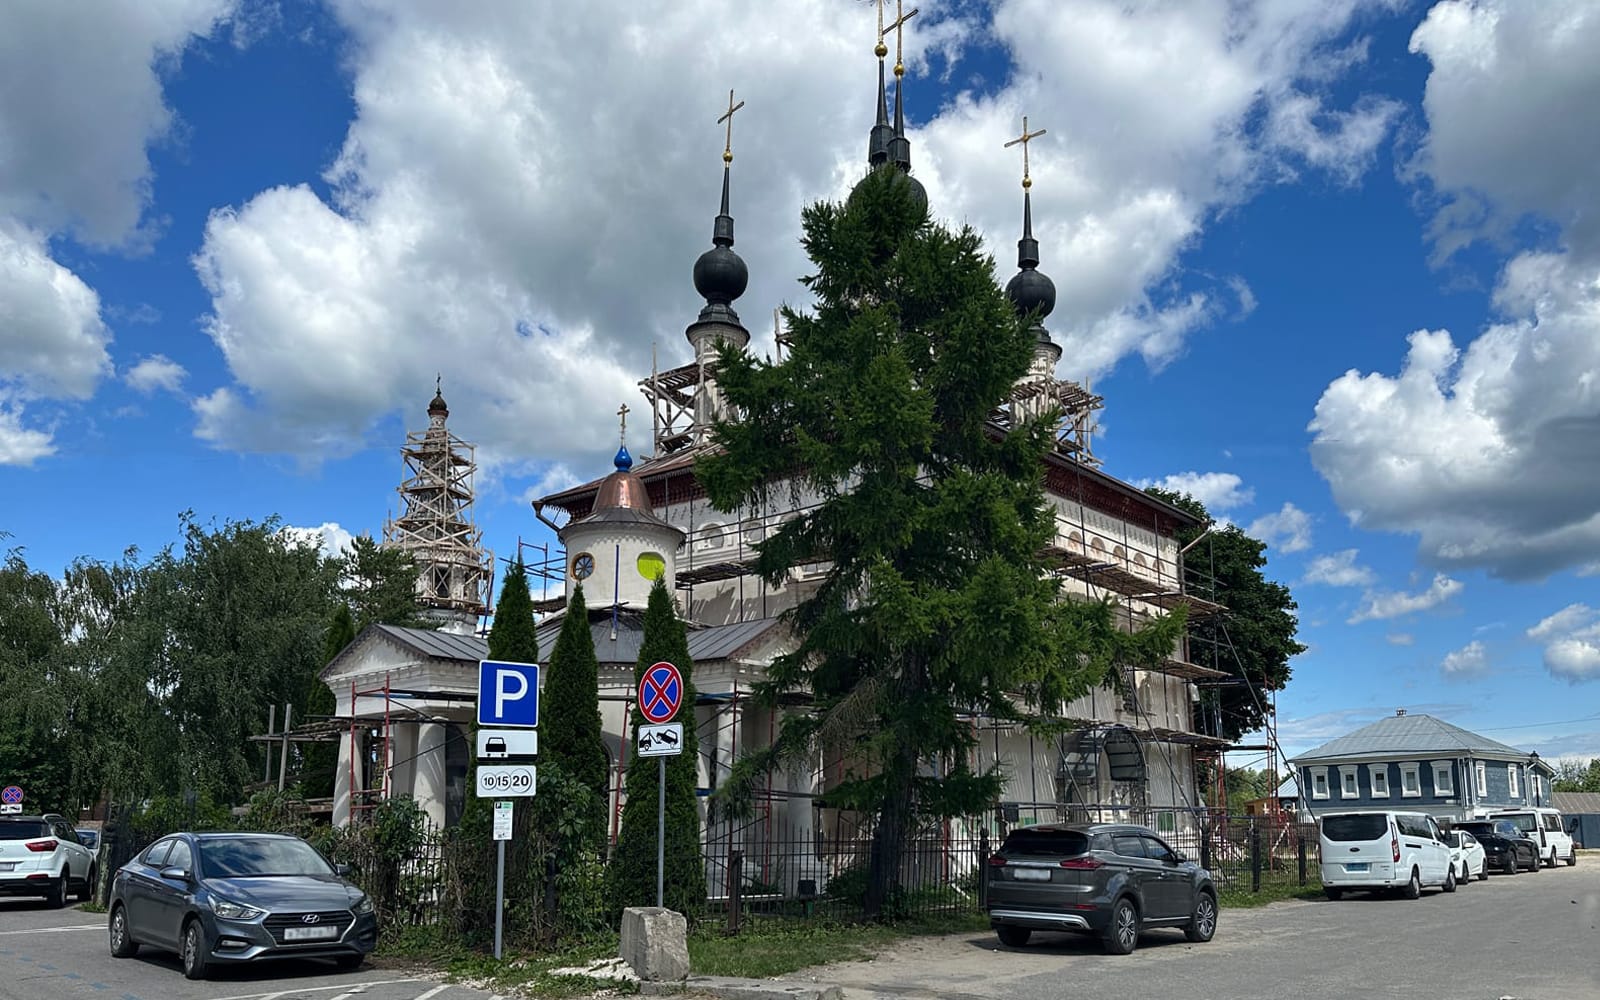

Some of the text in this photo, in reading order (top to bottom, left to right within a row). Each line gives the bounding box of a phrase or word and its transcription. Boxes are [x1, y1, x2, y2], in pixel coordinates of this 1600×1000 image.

[495, 669, 528, 718] P
[484, 775, 529, 786] 10 15 20
